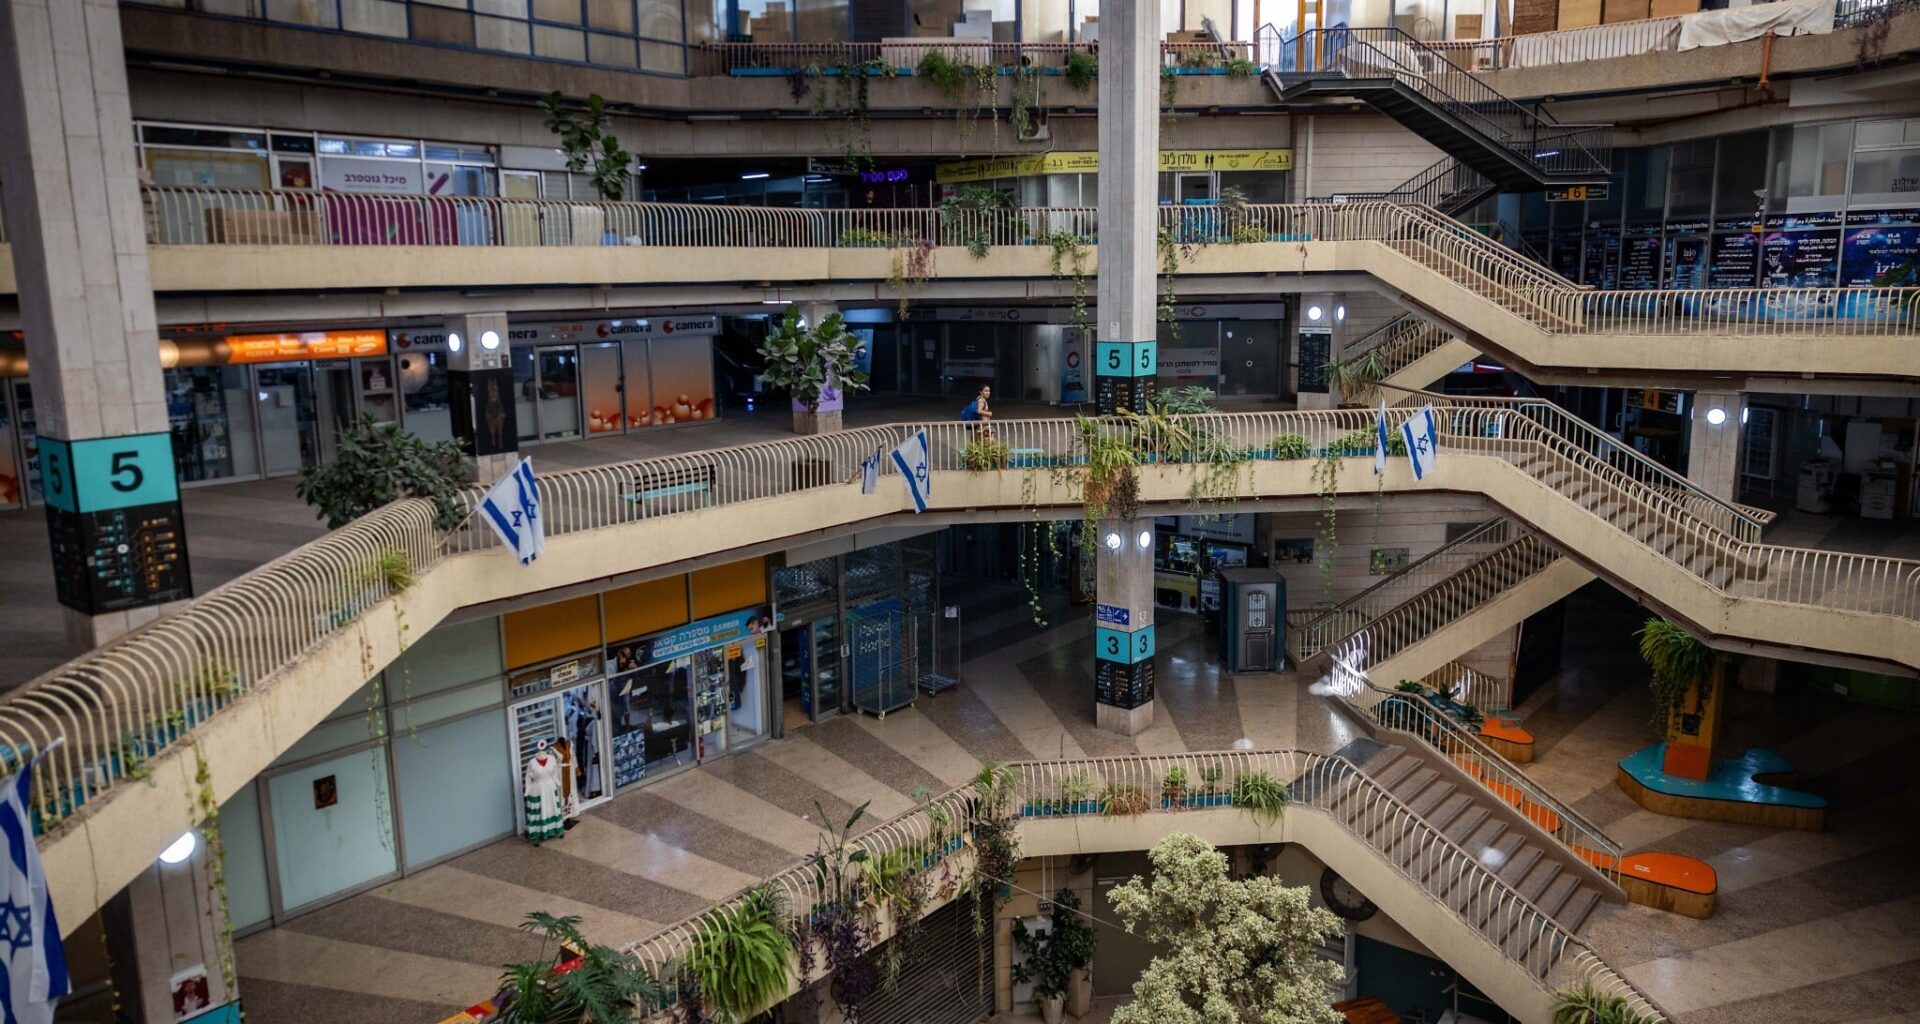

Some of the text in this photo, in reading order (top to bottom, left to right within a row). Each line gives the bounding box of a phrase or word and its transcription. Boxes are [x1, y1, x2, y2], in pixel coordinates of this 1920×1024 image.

[1178, 152, 1197, 166] גולדן
[382, 174, 407, 184] מיכל
[1574, 188, 1581, 198] 6
[610, 323, 652, 334] camera
[675, 319, 714, 331] camera
[1108, 349, 1121, 370] 5
[1141, 348, 1150, 369] 5
[49, 453, 63, 495] 5
[110, 450, 143, 493] 5
[859, 638, 891, 654] Home
[1107, 636, 1119, 655] 3
[1139, 634, 1148, 654] 3
